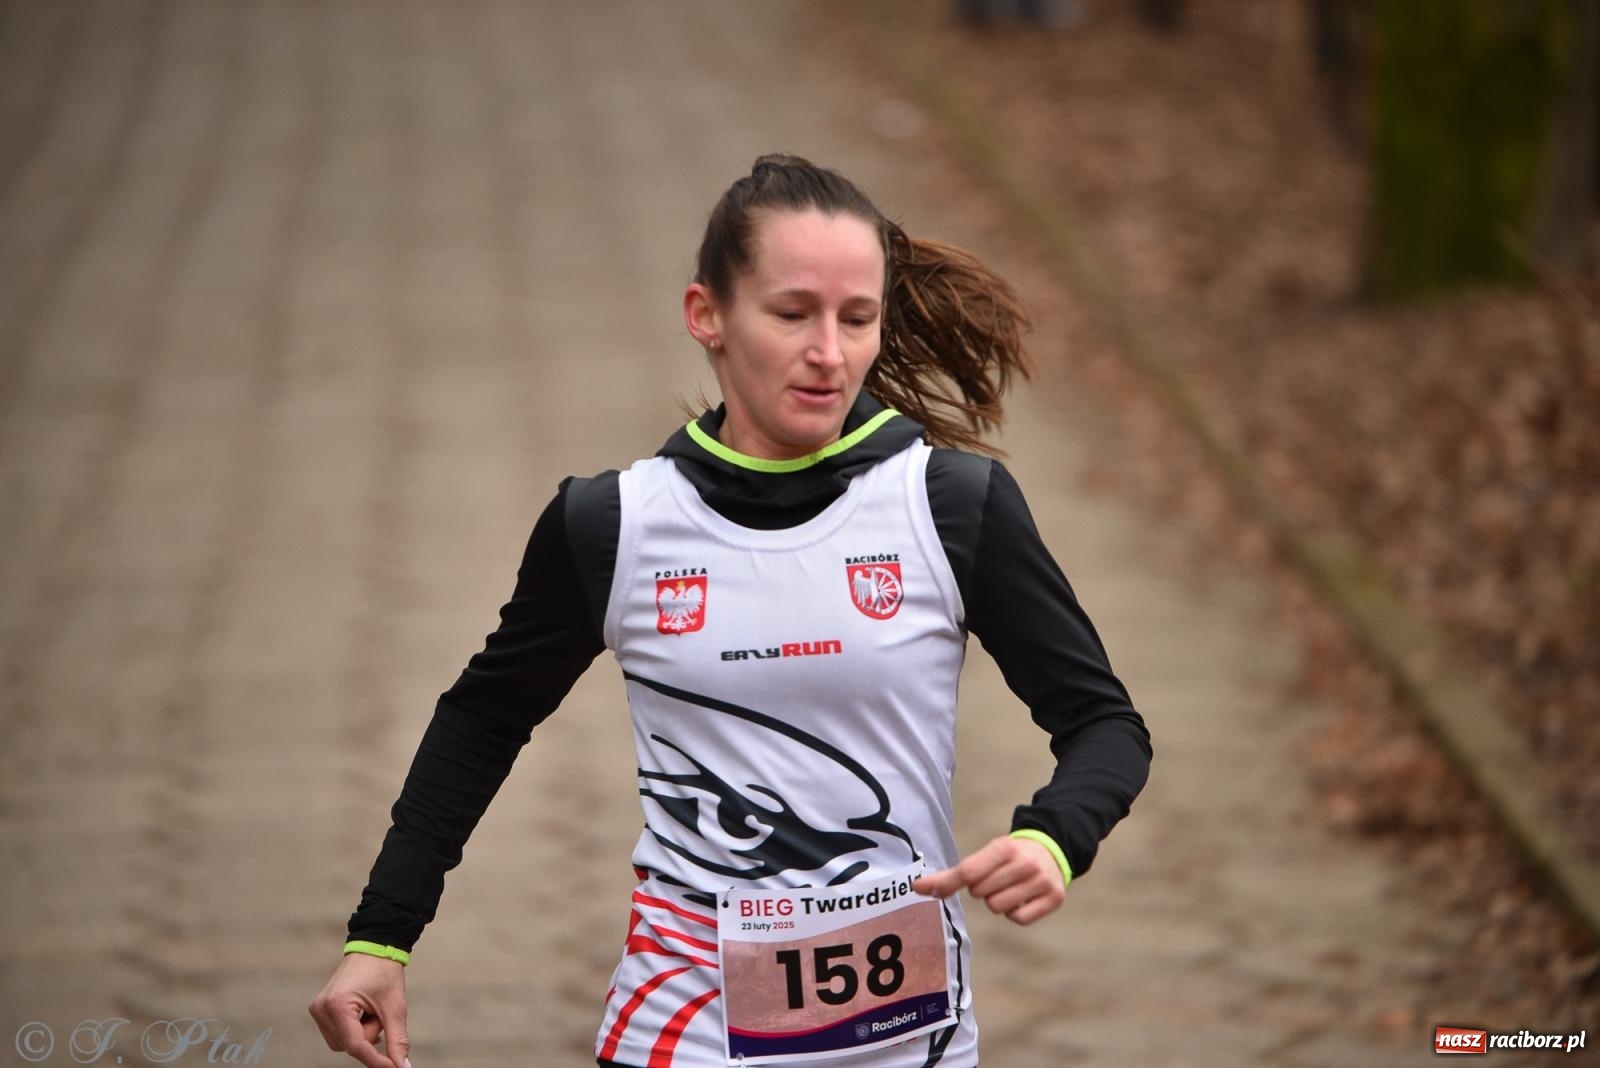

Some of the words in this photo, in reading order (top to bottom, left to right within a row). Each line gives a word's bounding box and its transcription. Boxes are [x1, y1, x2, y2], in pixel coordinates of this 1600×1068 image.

[845, 554, 900, 565] RACIBÓRZ
[655, 568, 708, 579] POLSKA
[740, 898, 794, 917] BIEG
[741, 922, 752, 931] 23
[753, 921, 771, 932] luty
[773, 920, 795, 930] 2025
[776, 934, 905, 1010] 158
[871, 1009, 918, 1033] Racibórz
